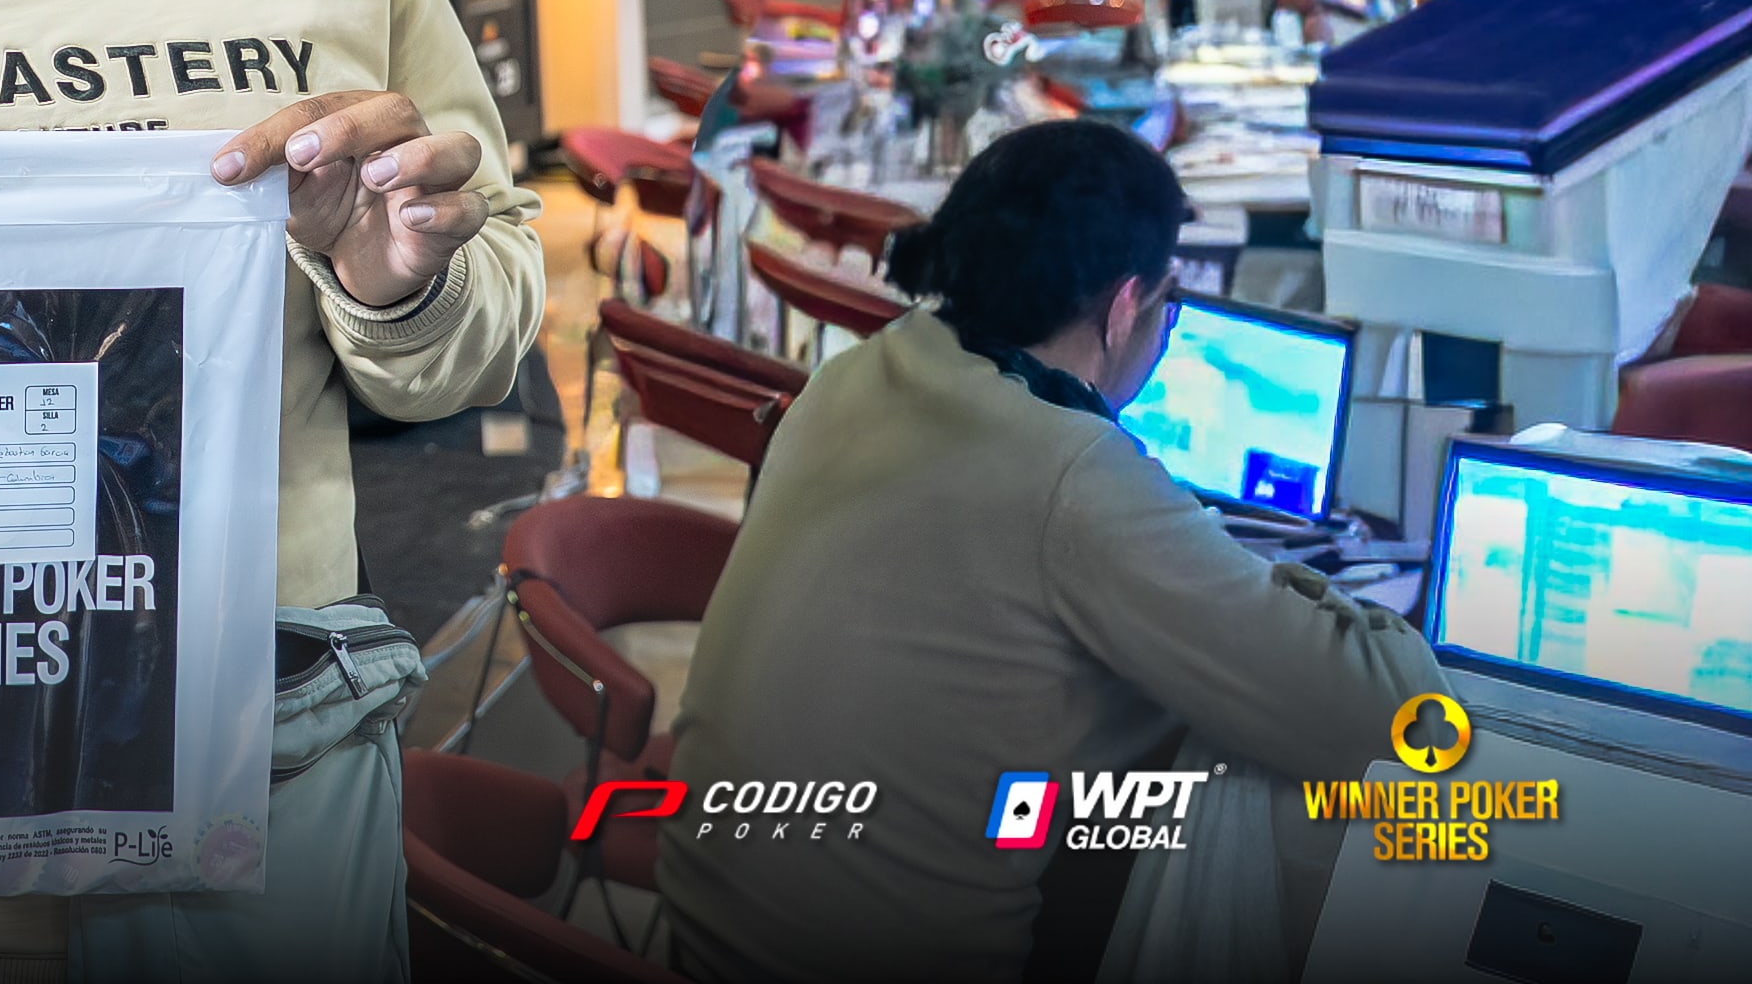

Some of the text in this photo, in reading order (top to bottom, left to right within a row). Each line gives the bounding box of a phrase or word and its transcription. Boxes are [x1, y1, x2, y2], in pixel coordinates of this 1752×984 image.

[42, 387, 59, 397] MESA
[42, 411, 59, 420] SILLA
[40, 423, 49, 432] 2
[3, 554, 156, 615] POKER
[98, 827, 107, 835] su
[13, 842, 22, 850] de
